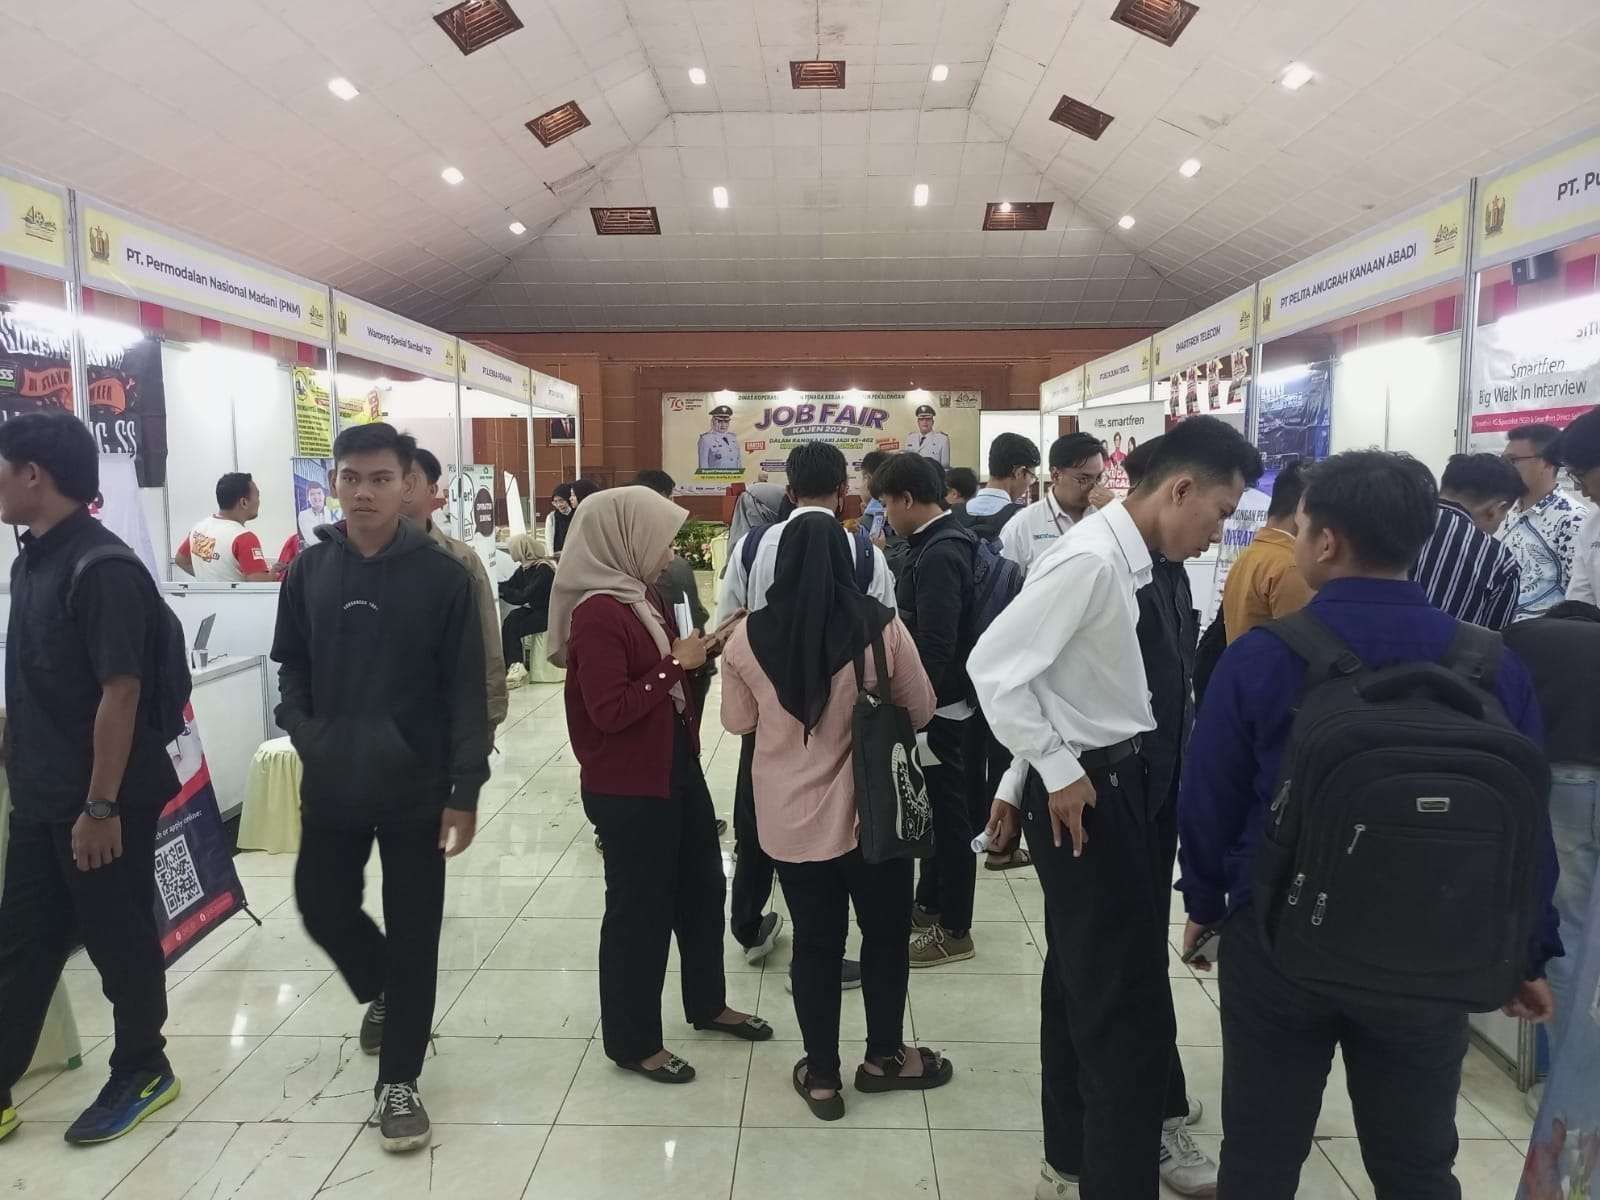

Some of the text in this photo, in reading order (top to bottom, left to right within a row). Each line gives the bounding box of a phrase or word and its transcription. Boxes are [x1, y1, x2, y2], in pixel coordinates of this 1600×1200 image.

[1557, 178, 1580, 201] PT.
[126, 247, 301, 318] PT. Permodalan Nasional Madani (PNM)
[1280, 243, 1417, 310] PT PELITA ANUGRAH KANAAN ABADI
[1199, 325, 1221, 344] TELECOM
[1479, 390, 1492, 408] Big
[1494, 386, 1518, 402] Walk
[1533, 379, 1587, 400] Interview
[754, 402, 890, 431] JOB FAIR
[1107, 414, 1145, 427] smartfren
